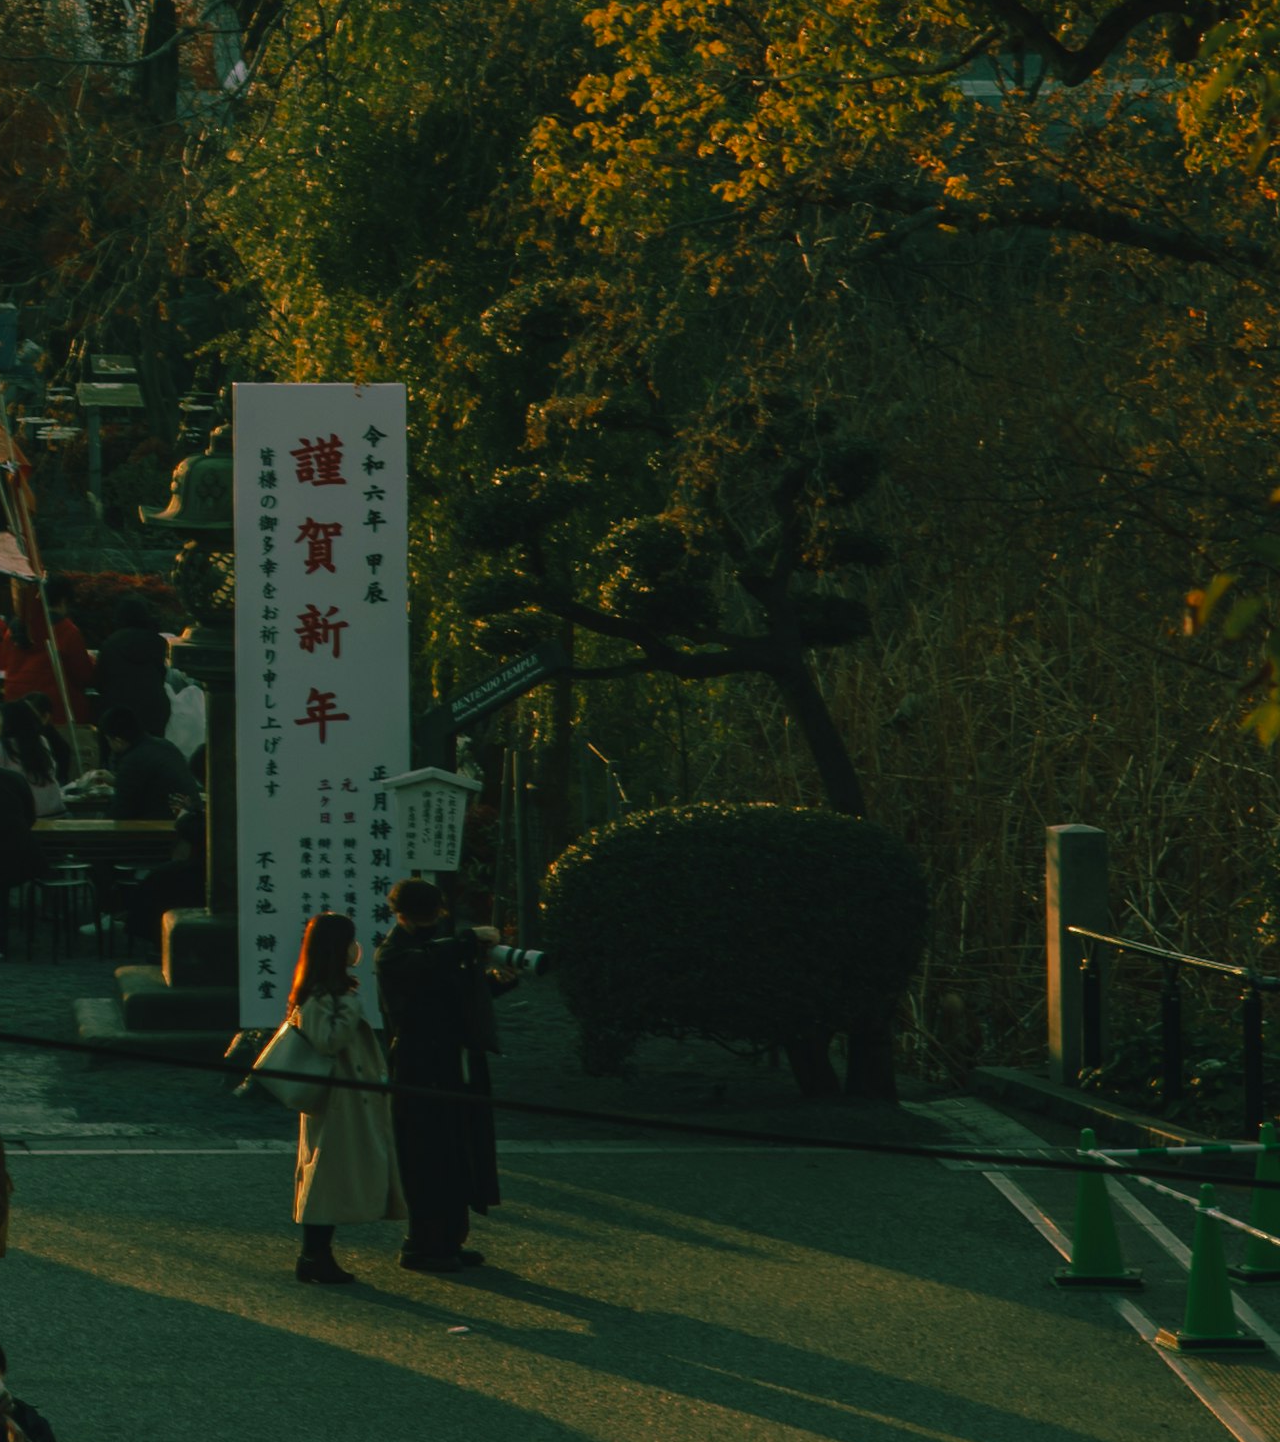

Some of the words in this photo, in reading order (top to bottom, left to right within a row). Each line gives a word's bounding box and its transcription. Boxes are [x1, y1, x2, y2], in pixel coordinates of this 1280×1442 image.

[362, 425, 388, 532] 令和六年
[289, 433, 351, 744] 謹賀新年
[364, 554, 390, 604] 甲辰
[258, 447, 283, 798] 皆様の御多幸をお祈り申し上げます
[451, 675, 501, 713] BENTENDO
[501, 653, 539, 682] TEMPLE
[340, 777, 358, 825] 元旦
[255, 851, 277, 915] 不忍池
